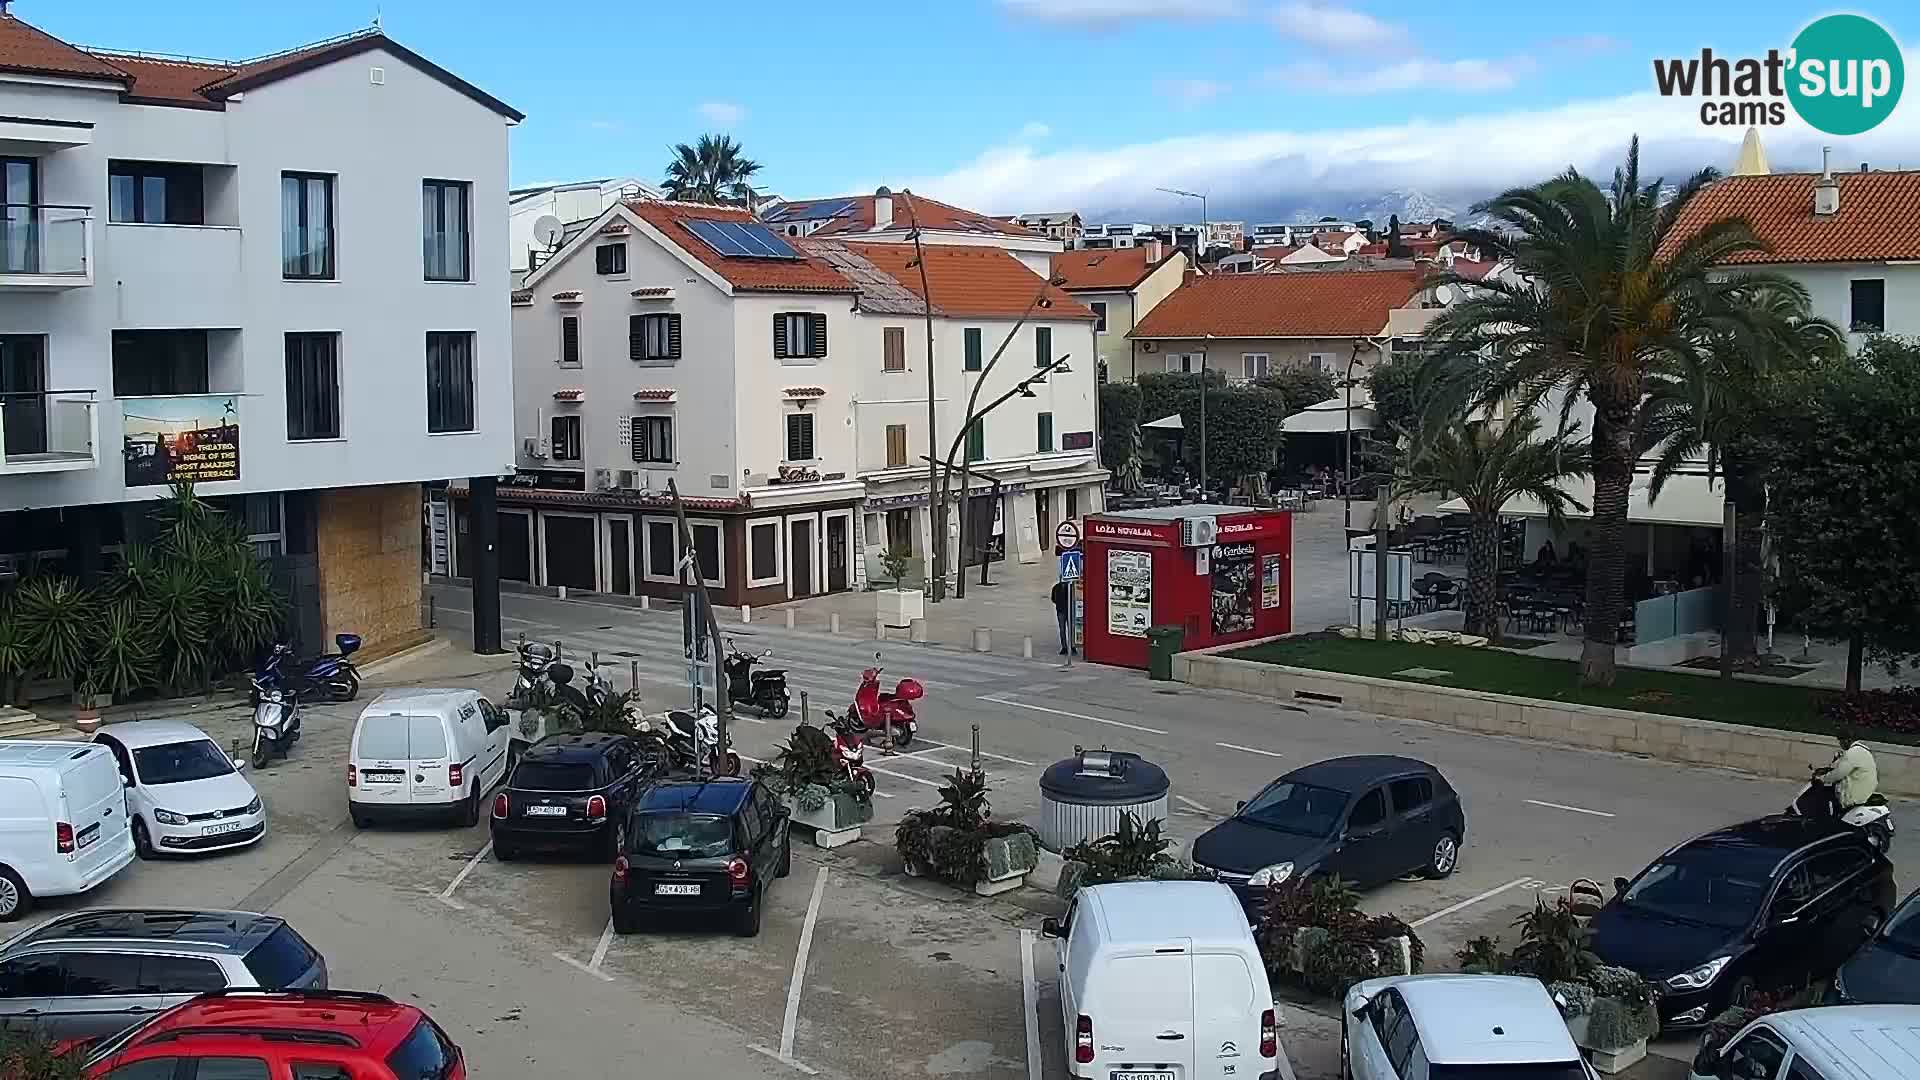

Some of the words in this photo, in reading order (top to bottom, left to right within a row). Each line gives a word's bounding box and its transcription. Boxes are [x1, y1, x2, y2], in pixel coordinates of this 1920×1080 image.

[208, 452, 219, 460] OF
[221, 451, 236, 460] THE
[175, 462, 199, 471] MOST
[200, 461, 235, 469] AMAZING
[1117, 527, 1153, 537] NOVALJA
